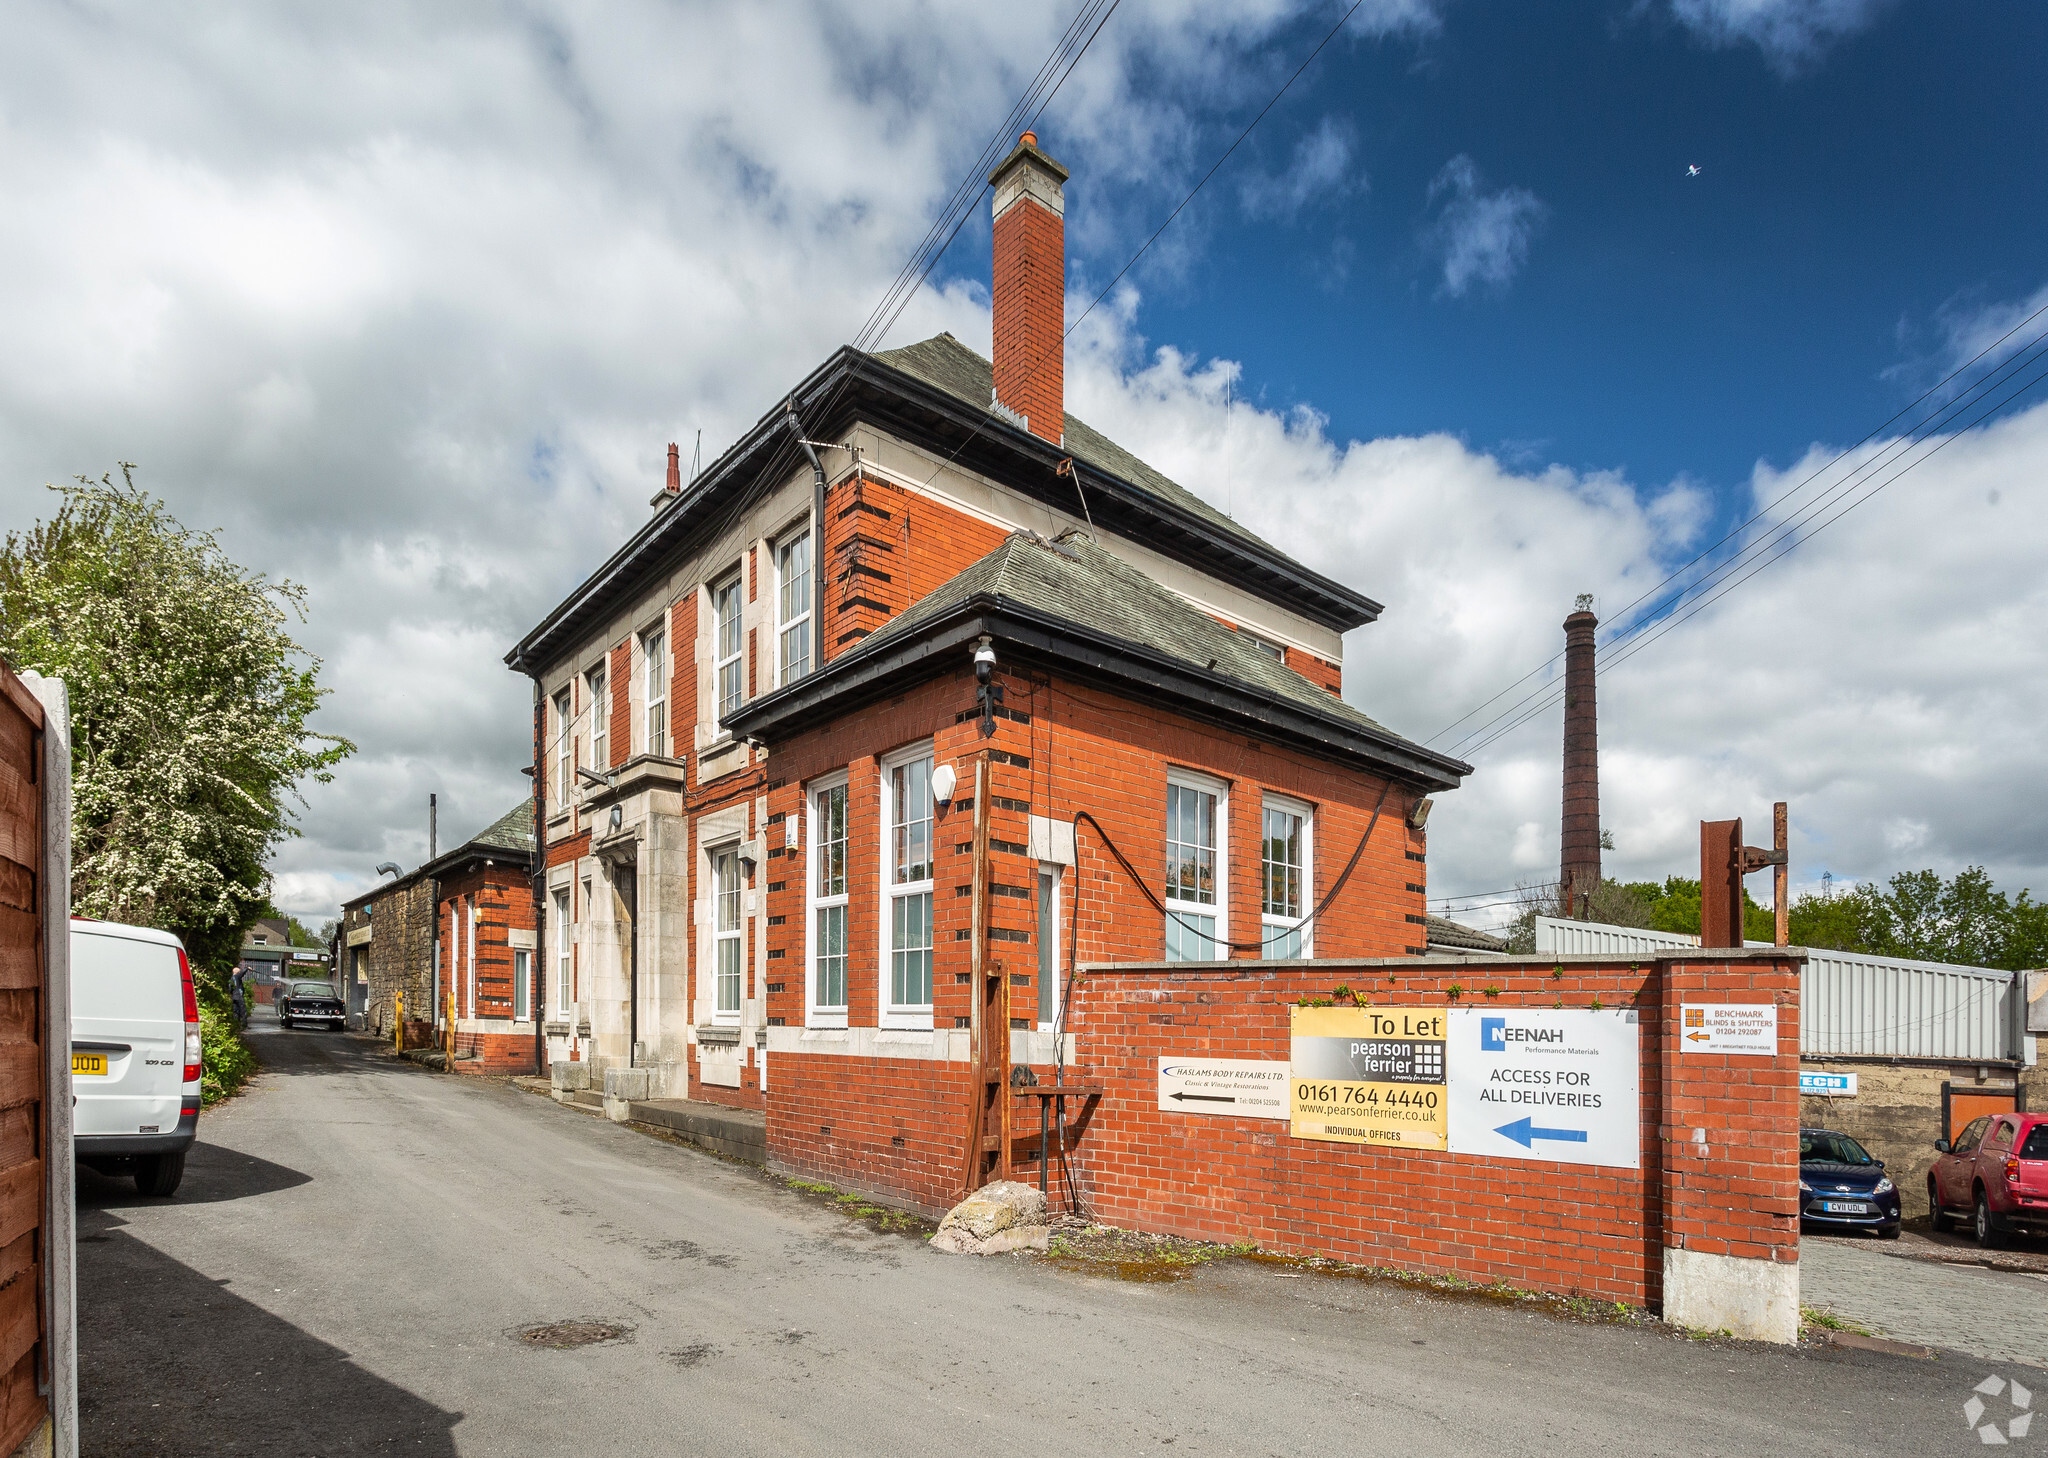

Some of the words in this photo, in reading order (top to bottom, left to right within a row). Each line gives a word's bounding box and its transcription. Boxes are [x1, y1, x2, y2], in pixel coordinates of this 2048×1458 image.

[1714, 1010, 1764, 1018] BENCHMARK
[1370, 1014, 1395, 1035] To
[1404, 1015, 1440, 1036] Let
[1492, 1027, 1563, 1042] NEENAH
[1351, 1042, 1411, 1058] pearson
[1525, 1046, 1566, 1054] Performance
[1365, 1056, 1411, 1073] ferrier
[1213, 1070, 1233, 1078] BODY
[1234, 1071, 1266, 1080] REPAIRS
[1268, 1072, 1284, 1080] LTD.
[1490, 1068, 1551, 1084] ACCESS
[1556, 1072, 1590, 1086] FOR
[1800, 1076, 1840, 1087] ECH
[1298, 1084, 1337, 1102] 0161
[1344, 1087, 1379, 1105] 764
[1385, 1089, 1438, 1108] 4440
[1480, 1088, 1507, 1102] ALL
[1511, 1090, 1602, 1108] DELIVERIES
[1299, 1104, 1437, 1122] www.pearsonferrier.co.uk
[1324, 1126, 1367, 1137] INDIVIDUAL
[1370, 1130, 1401, 1141] OFFICES
